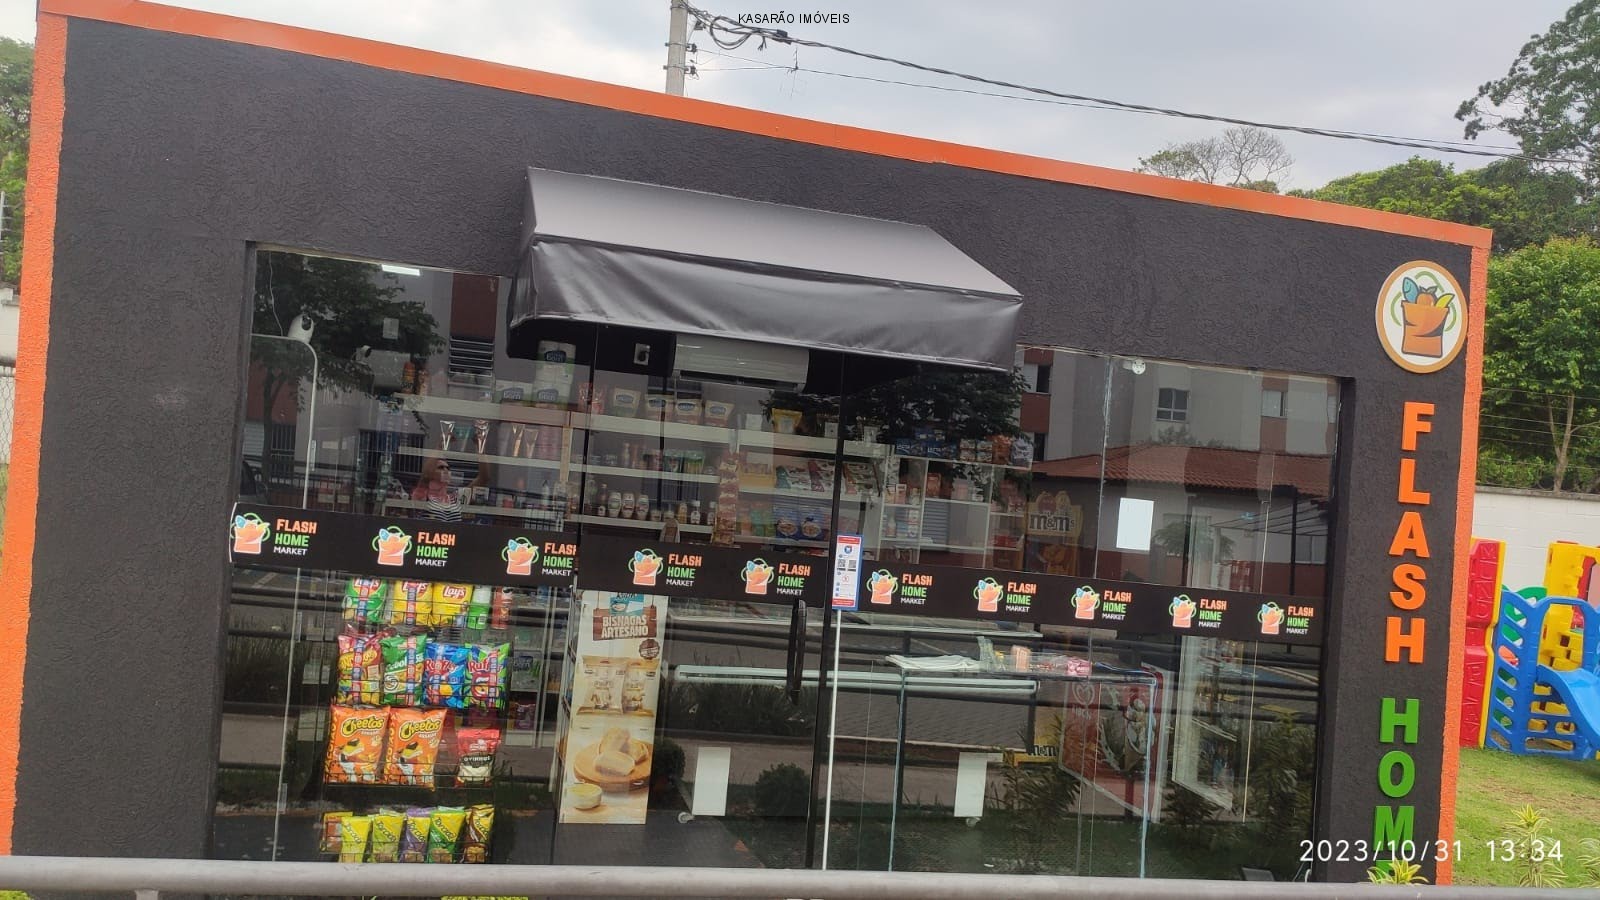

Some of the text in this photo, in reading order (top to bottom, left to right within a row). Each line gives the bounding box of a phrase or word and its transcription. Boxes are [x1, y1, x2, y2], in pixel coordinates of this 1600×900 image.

[276, 518, 318, 535] FLASH
[1385, 401, 1435, 664] FLASH
[274, 533, 309, 547] HOME
[417, 531, 456, 547] FLASH
[273, 546, 308, 556] MARKET
[416, 546, 449, 558] HOME
[415, 558, 446, 568] MARKET
[542, 557, 573, 568] HOME
[668, 553, 702, 567] FLASH
[542, 568, 571, 576] MARKET
[667, 566, 696, 577] HOME
[778, 562, 811, 577] FLASH
[666, 578, 694, 587] MARKET
[778, 576, 805, 587] HOME
[903, 573, 933, 587] FLASH
[776, 587, 803, 596] MARKET
[901, 585, 927, 597] HOME
[1007, 581, 1037, 595] FLASH
[900, 596, 925, 605] MARKET
[1006, 594, 1031, 605] HOME
[1103, 589, 1132, 603] FLASH
[1005, 605, 1030, 613] MARKET
[1102, 603, 1127, 613] HOME
[1199, 598, 1228, 611] FLASH
[1102, 612, 1126, 620] MARKET
[1198, 611, 1223, 621] HOME
[1287, 605, 1314, 618] FLASH
[602, 615, 647, 626] BISNAGAS
[1198, 620, 1221, 629] MARKET
[1286, 618, 1309, 627] HOME
[601, 626, 649, 638] ARTESANO
[1285, 627, 1308, 635] MARKET
[341, 714, 385, 737] Cheetos
[399, 717, 441, 741] Cheetos
